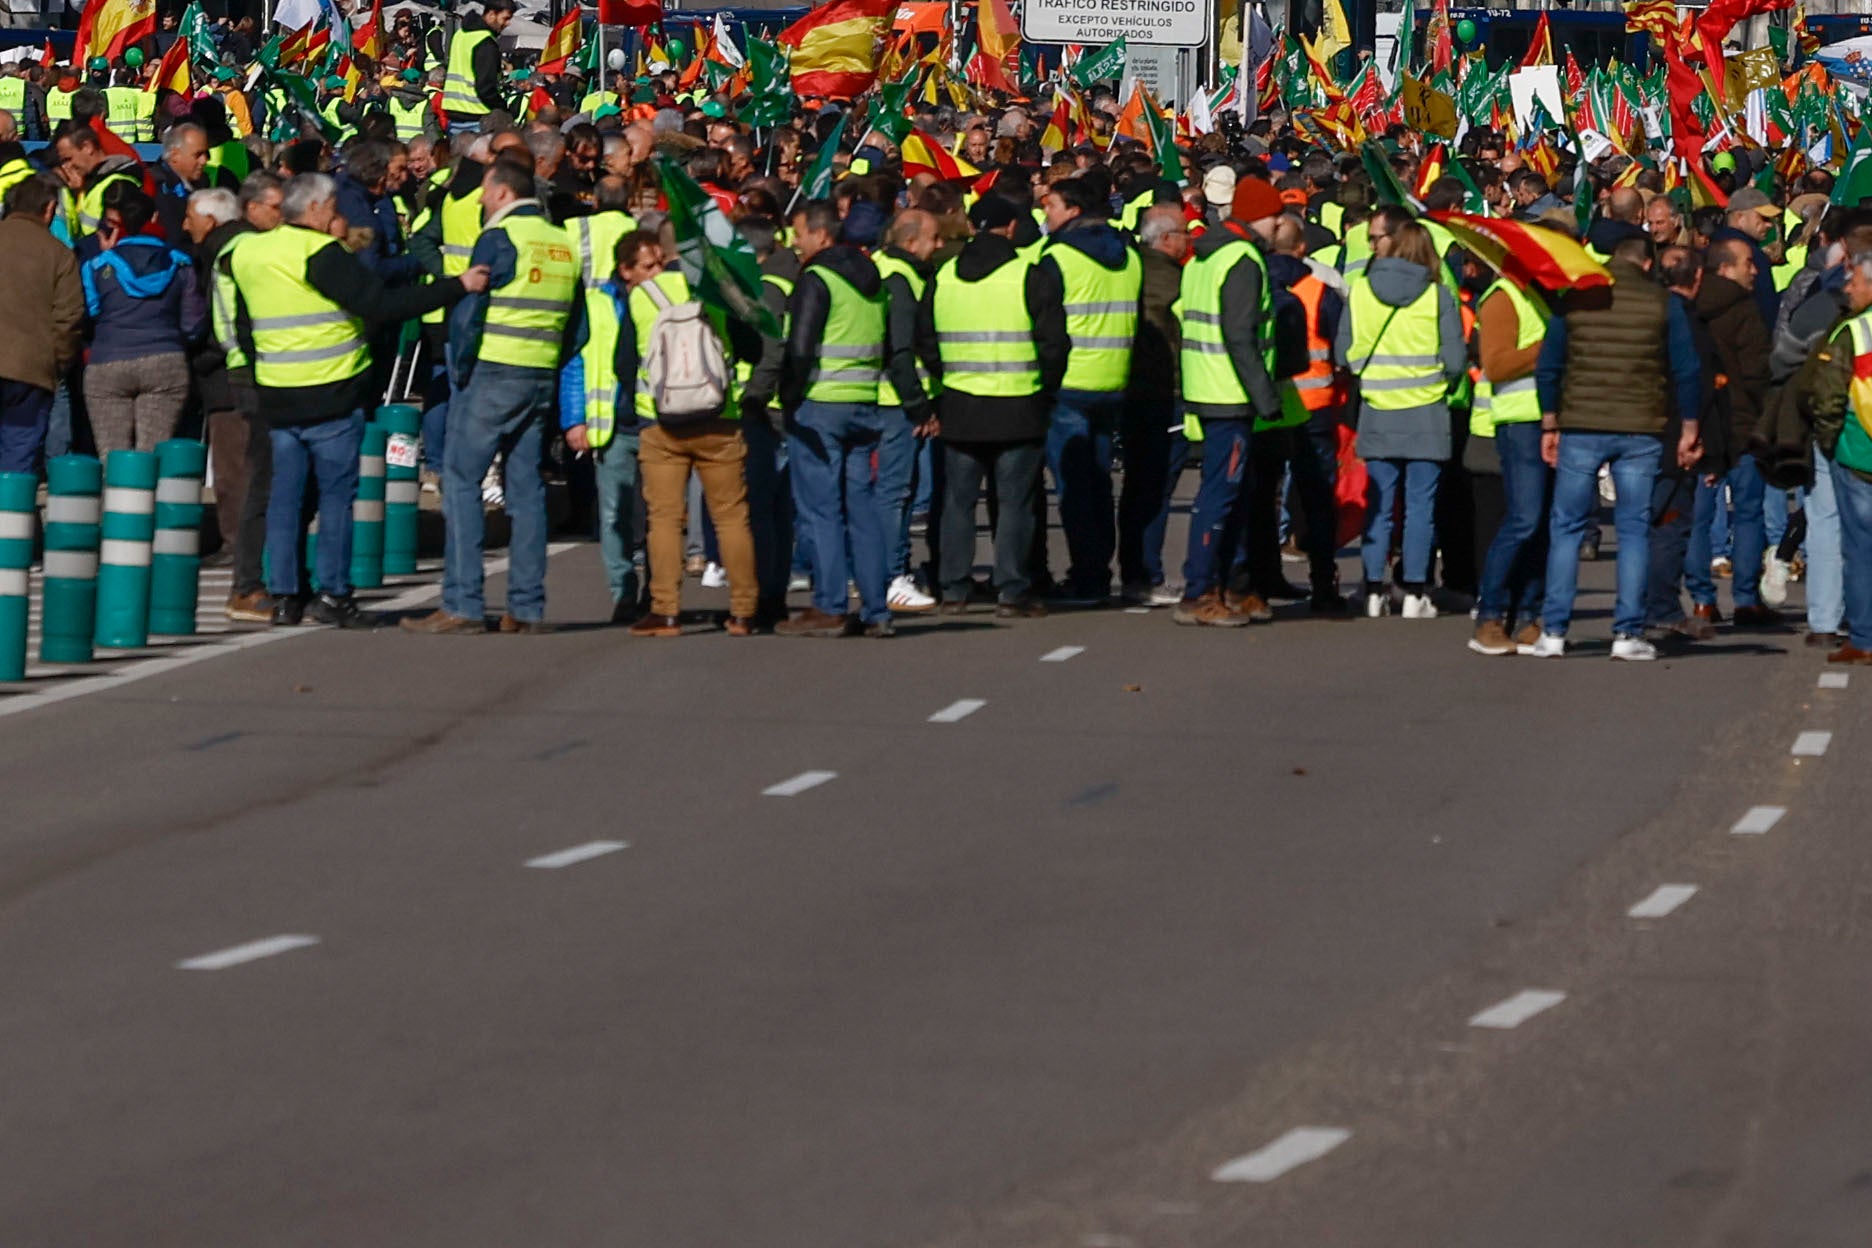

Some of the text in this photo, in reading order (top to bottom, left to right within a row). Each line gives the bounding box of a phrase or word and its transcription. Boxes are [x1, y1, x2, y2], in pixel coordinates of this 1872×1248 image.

[1058, 14, 1173, 28] EXCEPTO VEHÍCULOS
[1076, 28, 1154, 40] AUTORIZADOS
